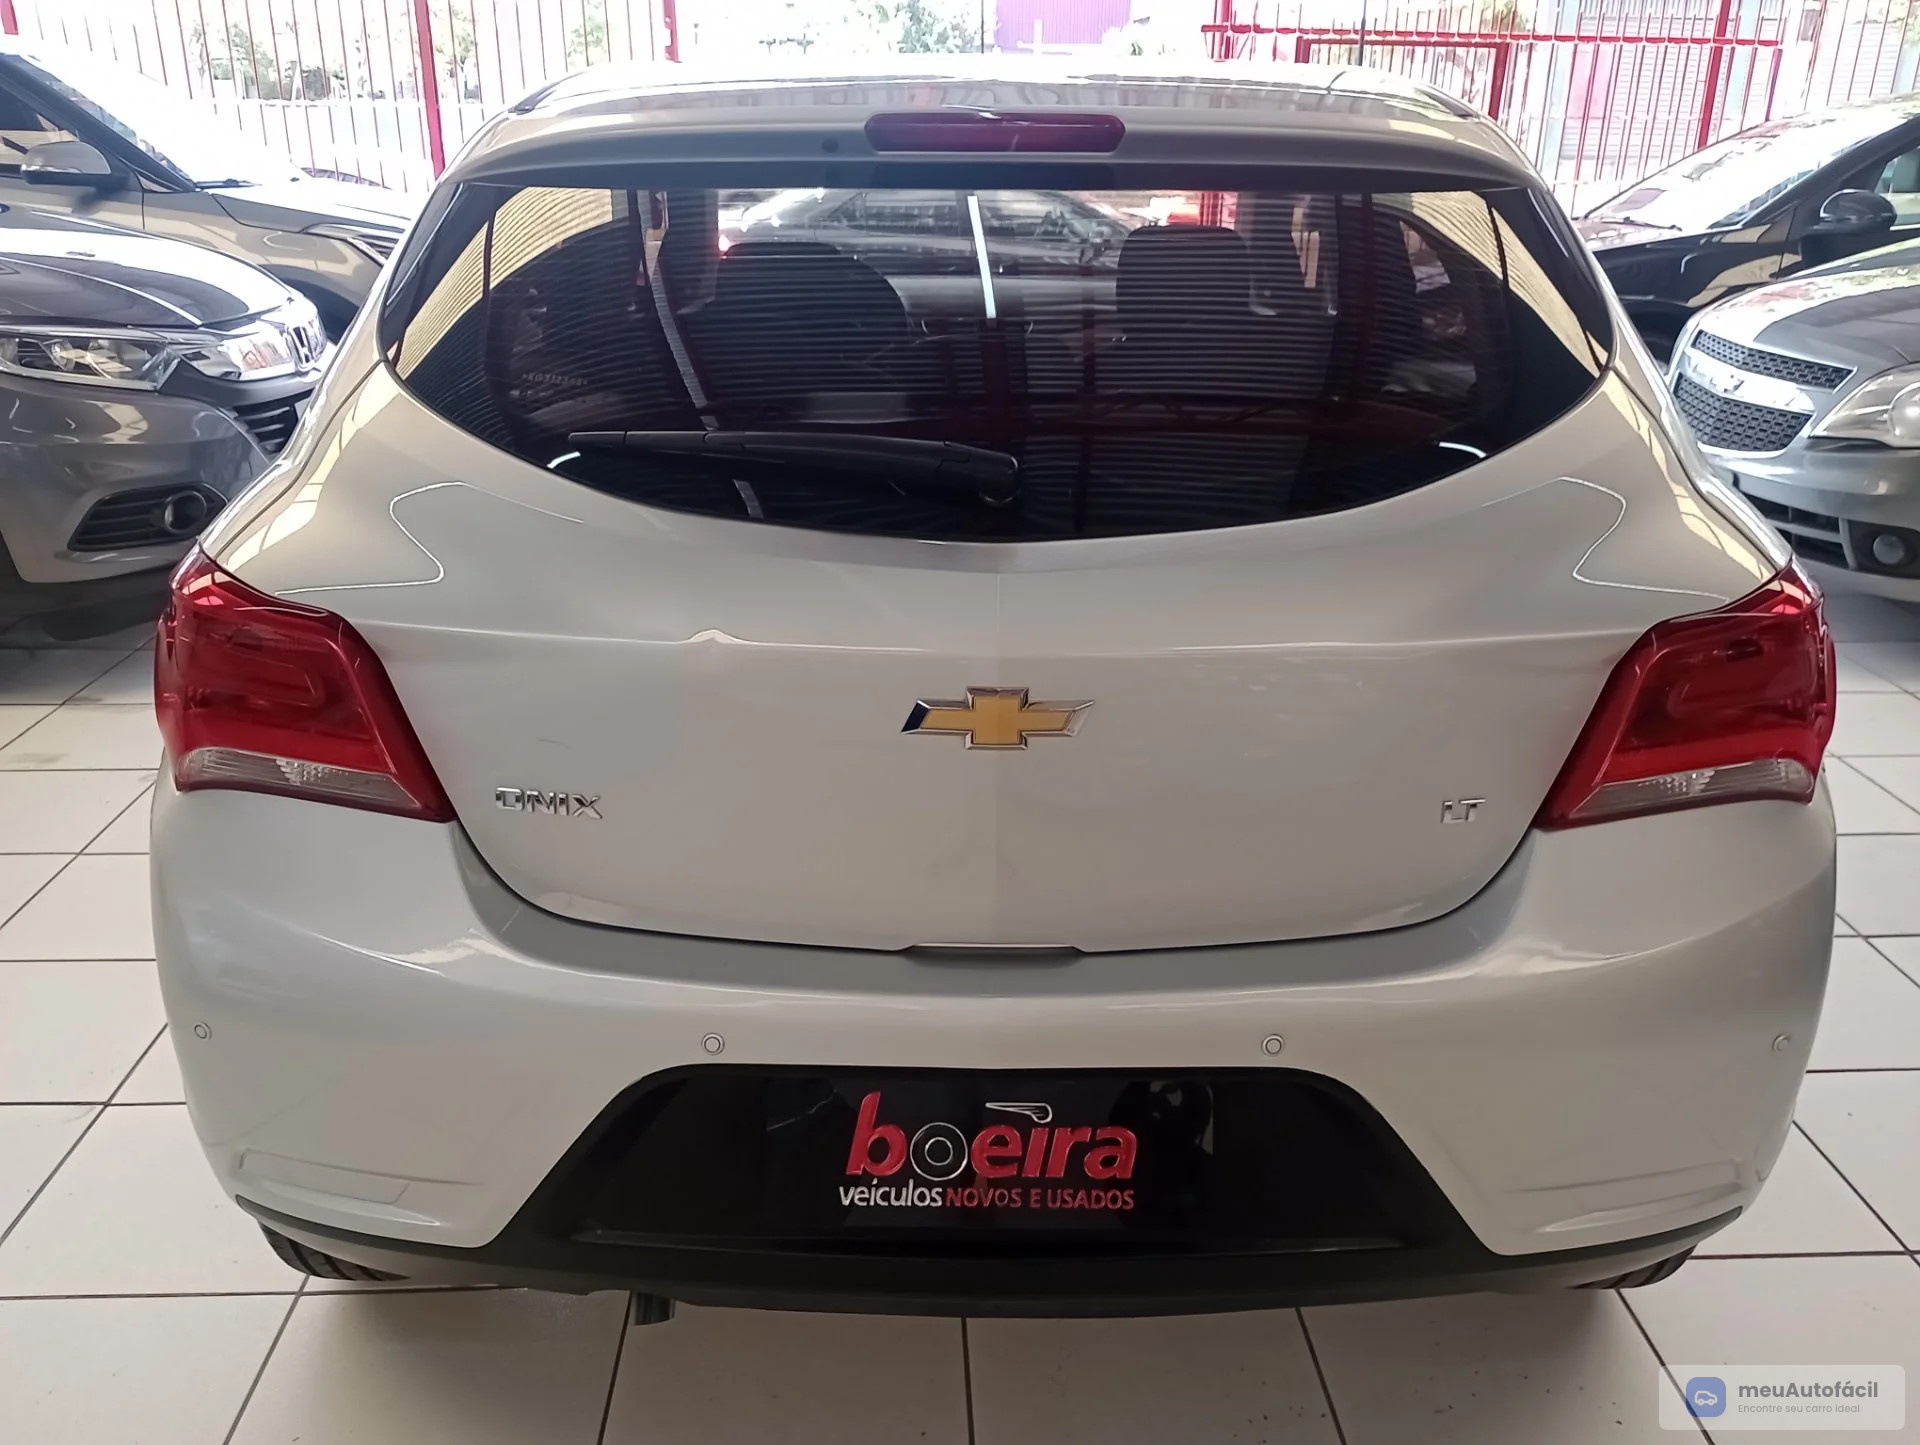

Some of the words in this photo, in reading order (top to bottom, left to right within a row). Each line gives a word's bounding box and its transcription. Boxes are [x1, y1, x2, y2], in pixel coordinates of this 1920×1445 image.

[495, 787, 603, 819] ONIX
[1440, 797, 1486, 824] LT
[846, 1091, 1138, 1181] boeira
[839, 1178, 943, 1207] veículos
[946, 1187, 1022, 1208] NOVOS
[1030, 1188, 1042, 1208] E
[1047, 1188, 1135, 1210] USADOS
